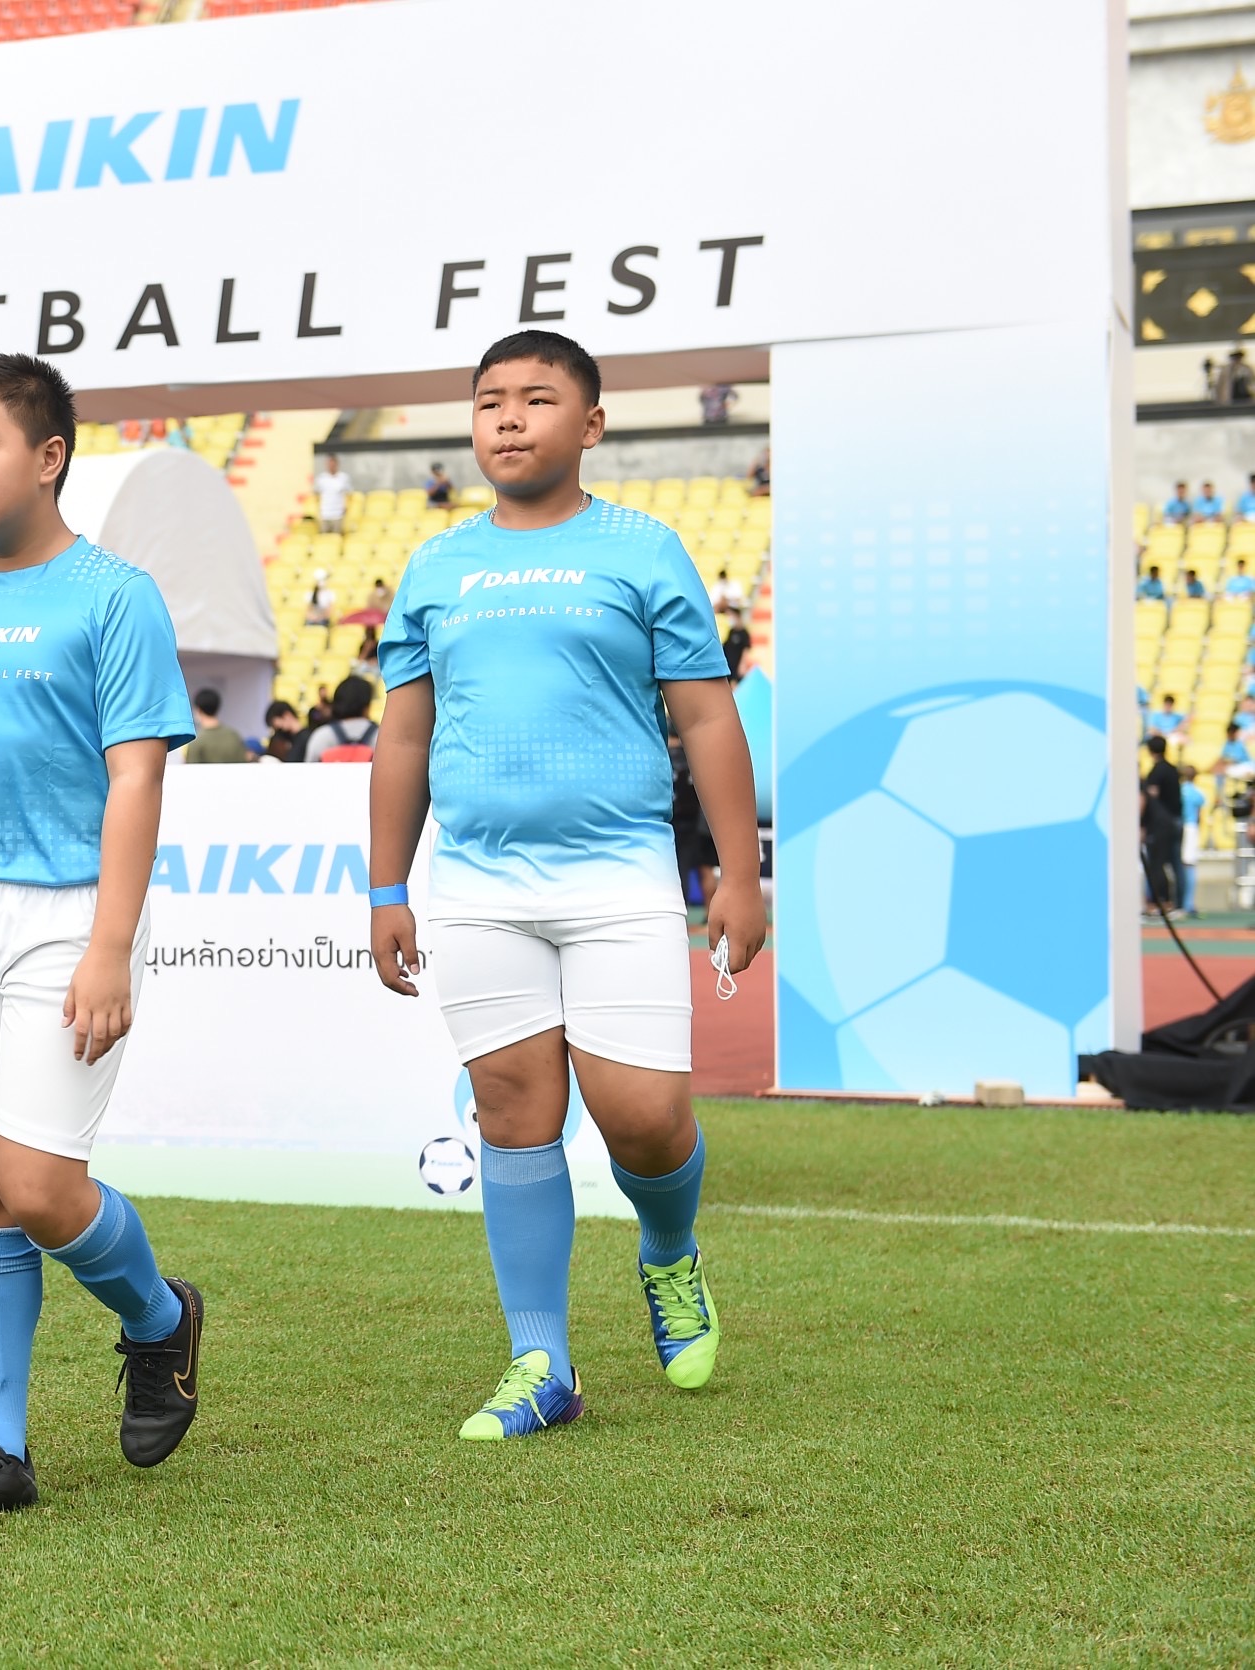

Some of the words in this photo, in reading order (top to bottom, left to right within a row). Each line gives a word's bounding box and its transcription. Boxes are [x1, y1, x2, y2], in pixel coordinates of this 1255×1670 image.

[434, 235, 764, 329] FEST
[483, 568, 586, 589] DAIKIN
[442, 613, 469, 628] KIDS
[477, 605, 556, 620] FOOTBALL
[565, 606, 604, 618] FEST
[16, 669, 53, 682] FEST
